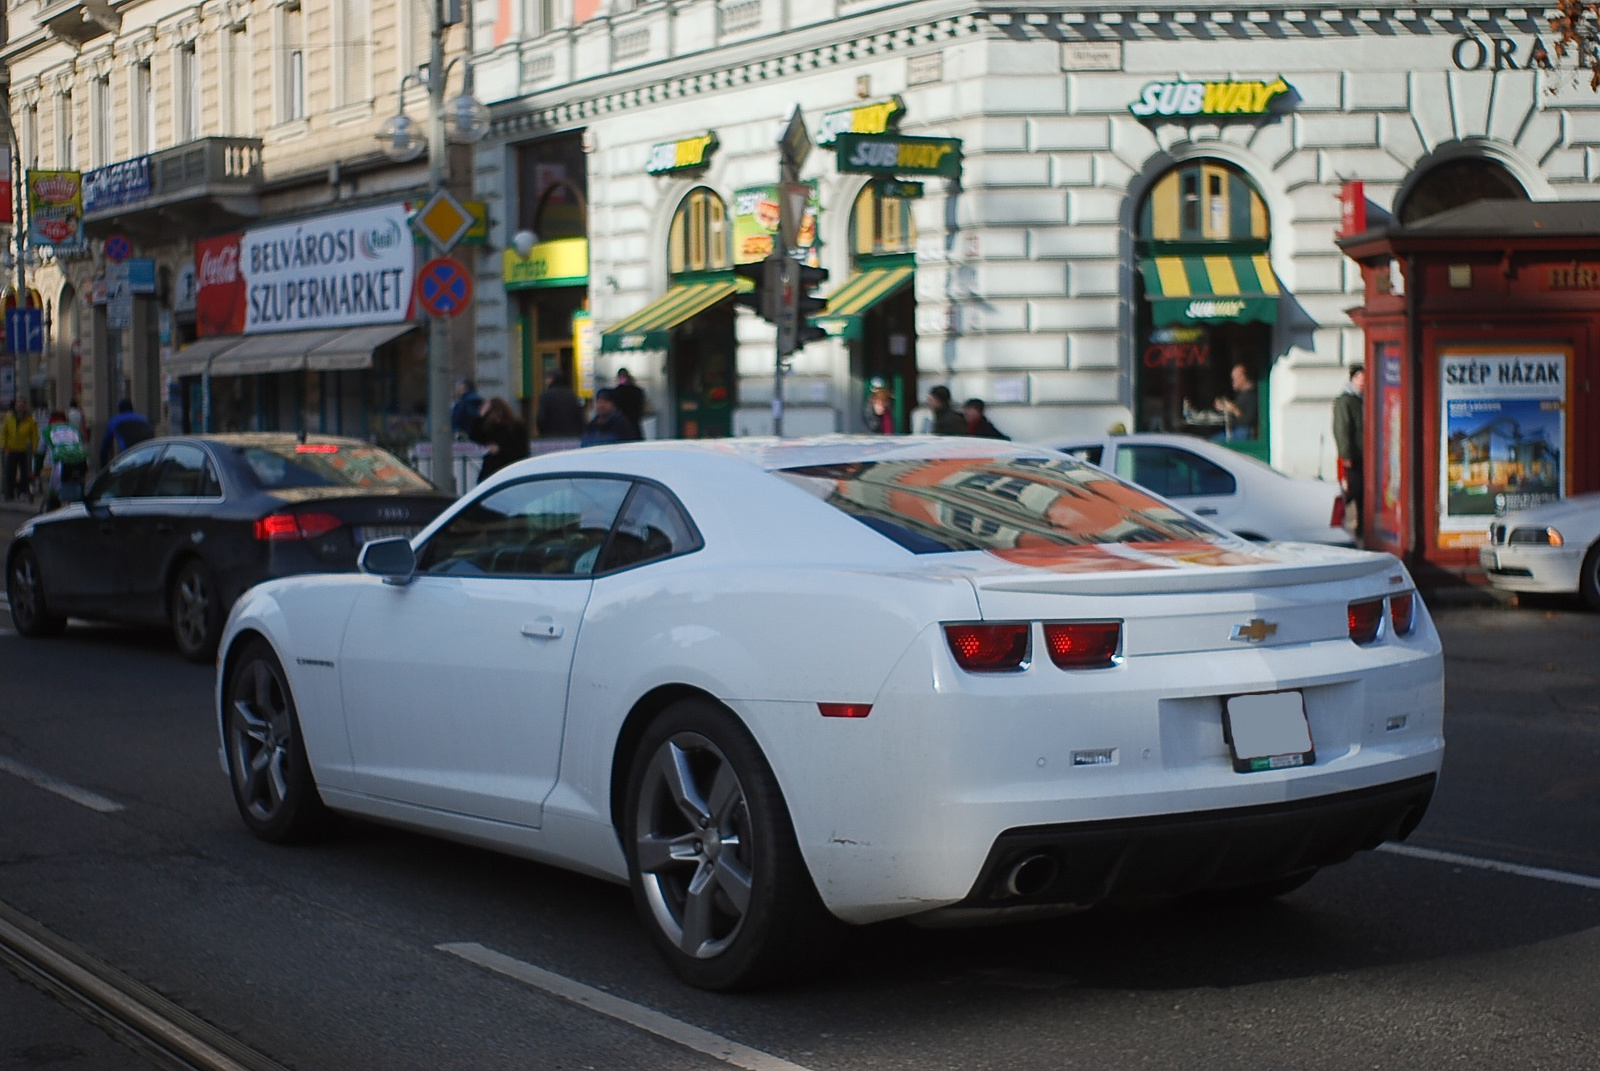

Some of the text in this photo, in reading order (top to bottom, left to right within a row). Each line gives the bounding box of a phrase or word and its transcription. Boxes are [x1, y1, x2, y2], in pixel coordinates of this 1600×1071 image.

[1130, 77, 1288, 116] SUBWAY
[850, 140, 952, 169] SUBWAY
[251, 226, 355, 274] BELVÁROSI
[250, 266, 404, 324] SZUPERMARKET
[1143, 343, 1211, 369] OPEN
[1446, 356, 1560, 384] SZÉP HÁZAK
